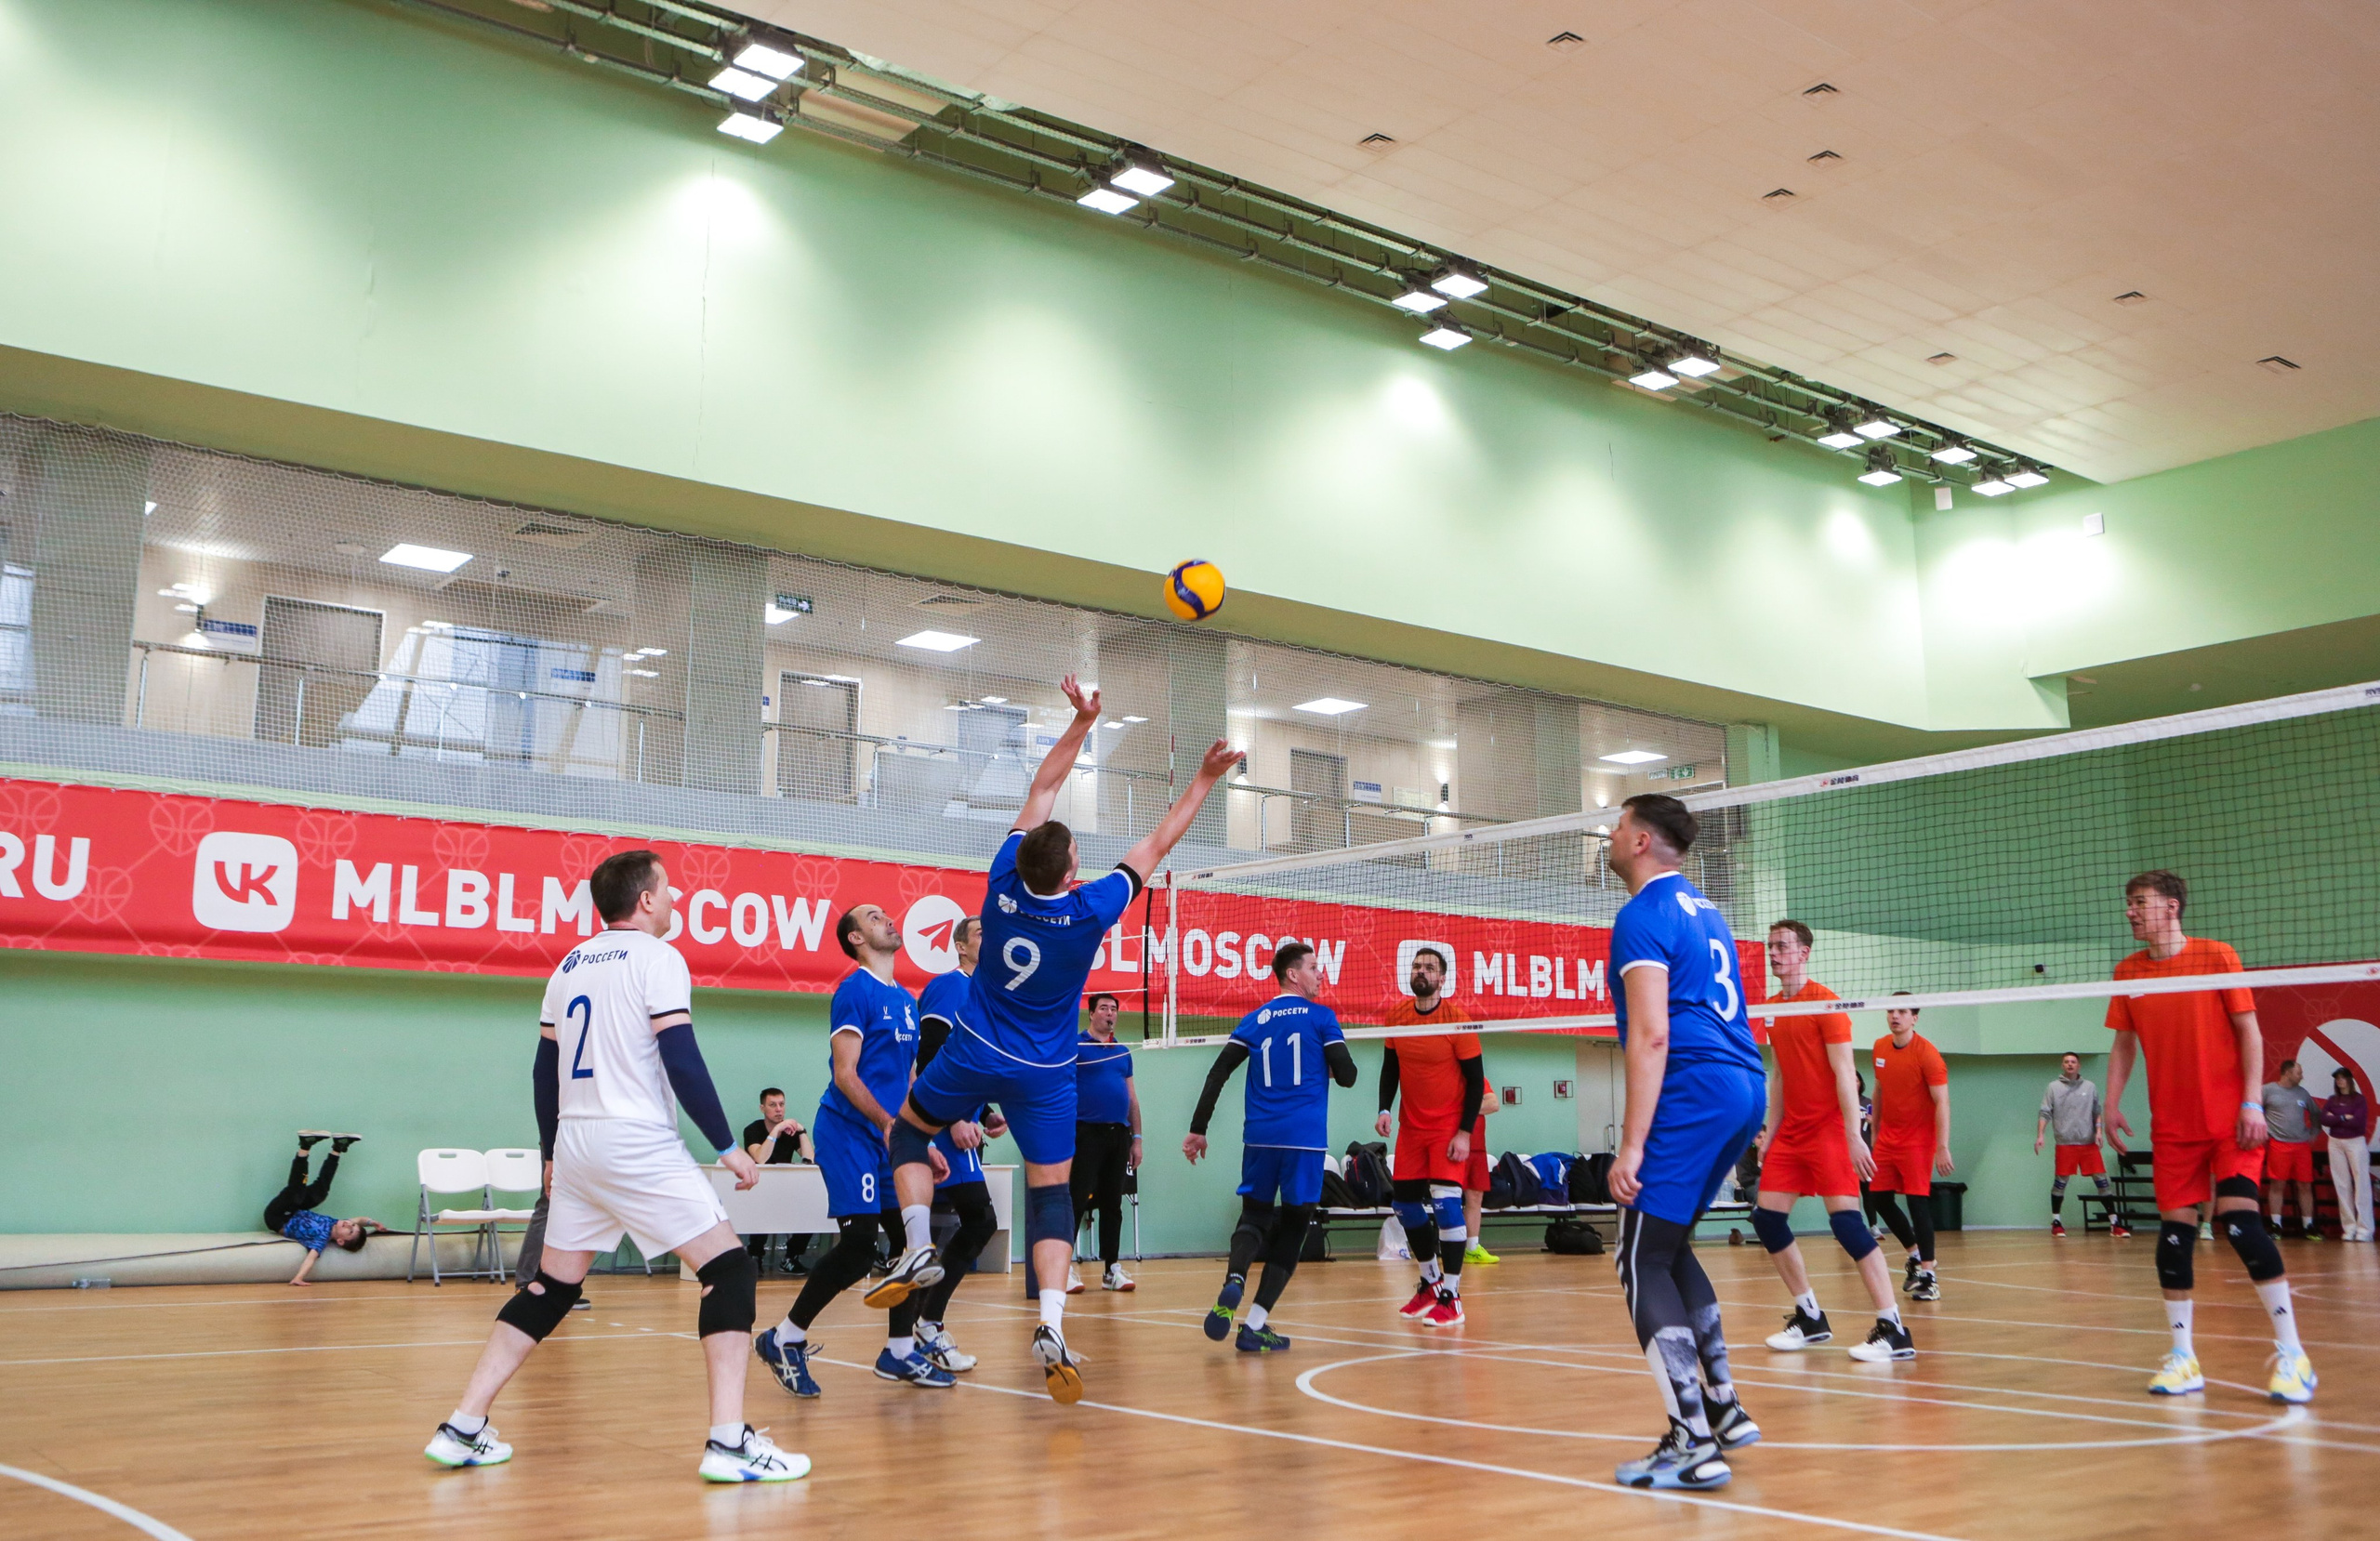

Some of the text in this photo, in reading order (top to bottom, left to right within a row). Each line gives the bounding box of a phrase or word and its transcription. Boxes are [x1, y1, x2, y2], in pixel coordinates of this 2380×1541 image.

[332, 859, 831, 952] MLBLMCOW
[582, 950, 628, 965] РОССЕТИ
[1003, 937, 1040, 991] 9
[1474, 951, 1613, 1001] MLBLM
[1709, 939, 1739, 1022] 3
[566, 994, 594, 1080] 2
[1273, 1007, 1309, 1018] РОССЕТИ
[1261, 1033, 1302, 1087] 11
[862, 1173, 875, 1203] 8
